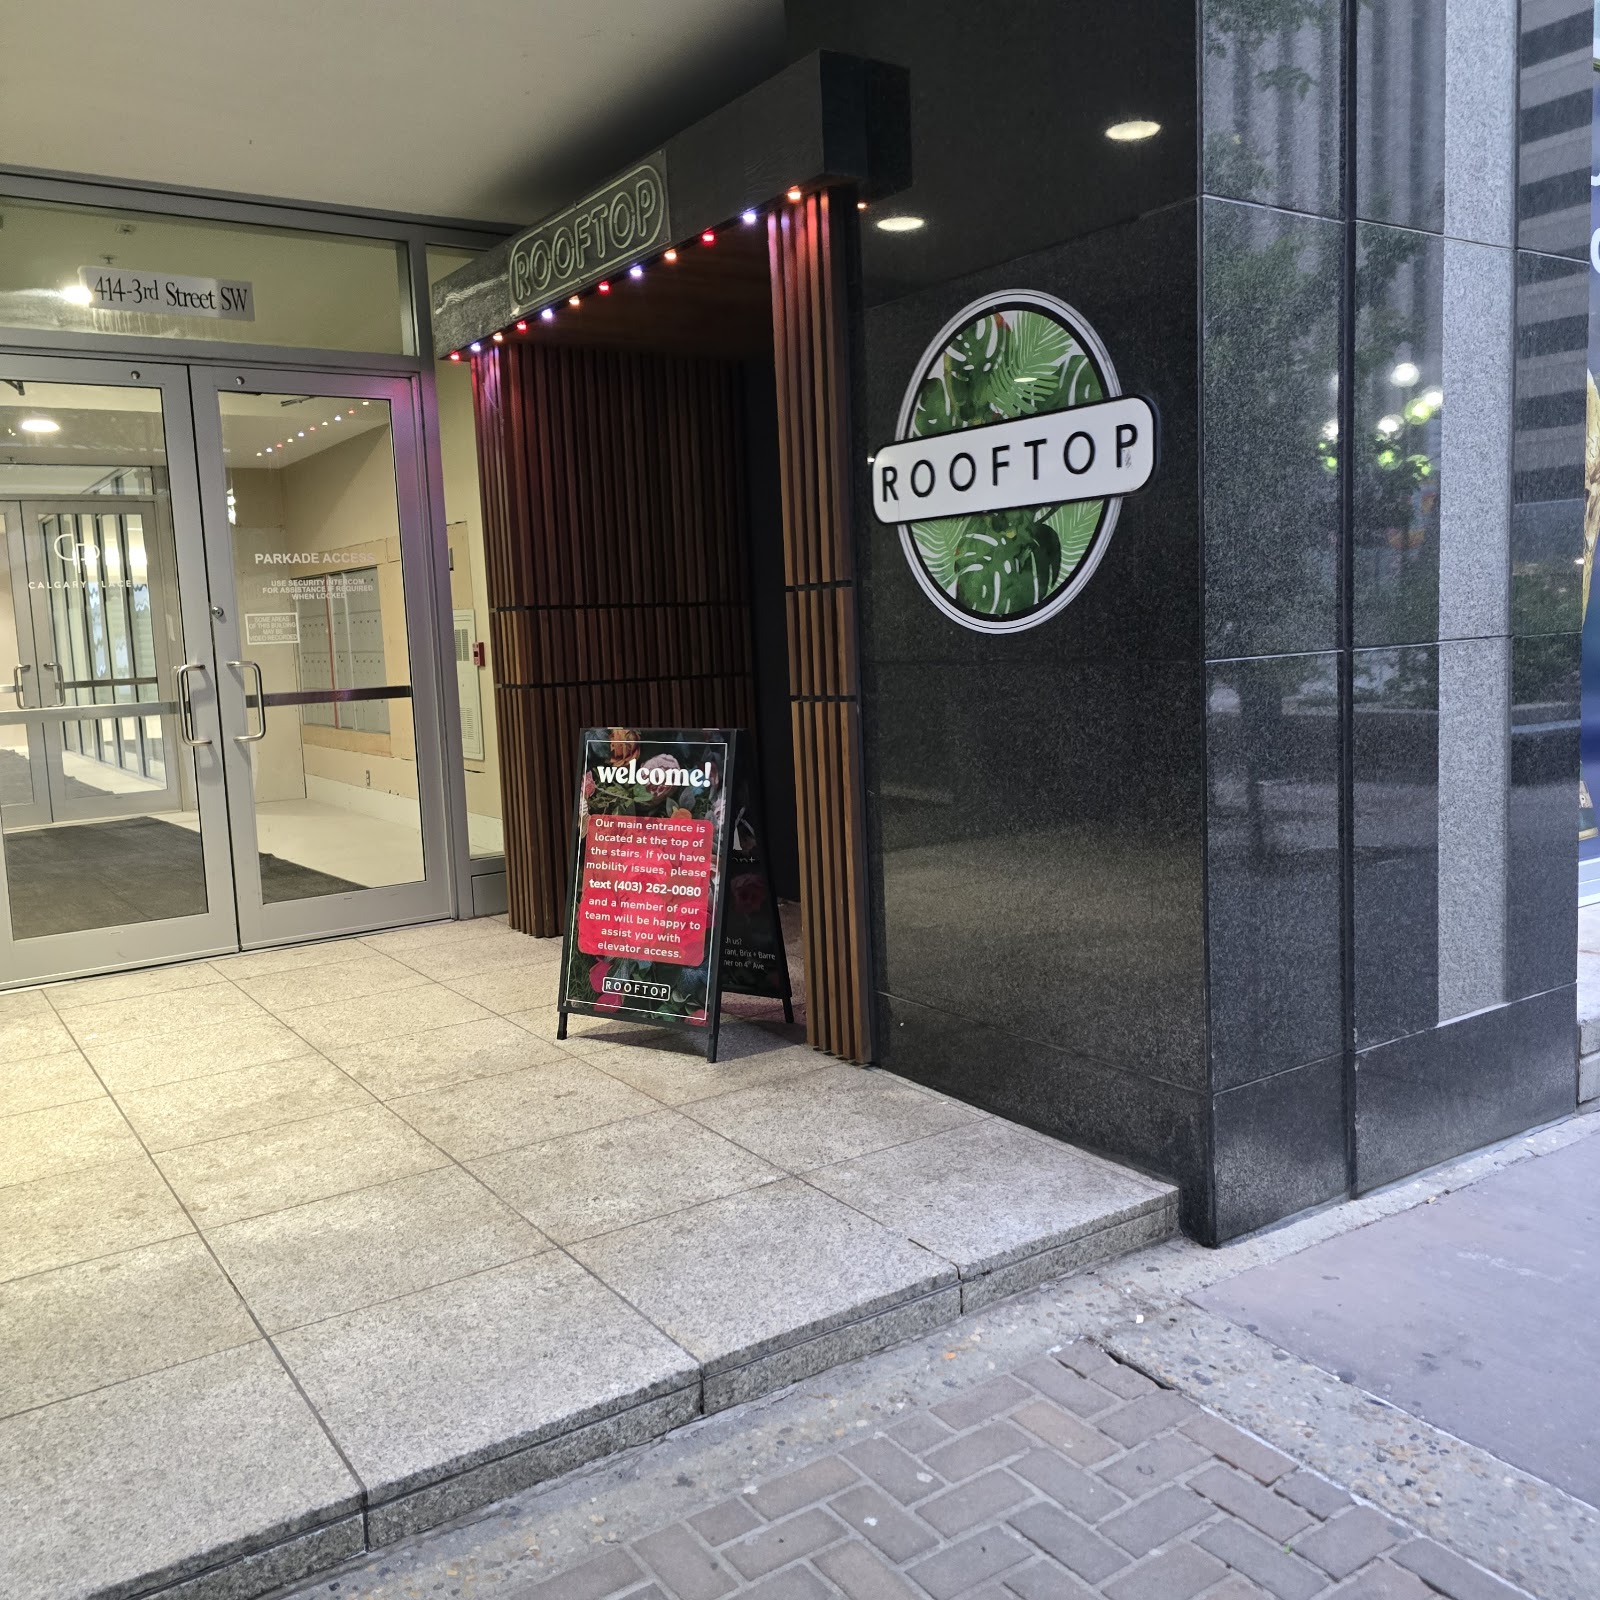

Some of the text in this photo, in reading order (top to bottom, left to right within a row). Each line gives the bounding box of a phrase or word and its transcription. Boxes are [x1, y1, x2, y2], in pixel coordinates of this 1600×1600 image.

[514, 179, 656, 300] ROOFTOP
[95, 276, 247, 311] 414-3rd Street SW
[882, 423, 1138, 502] ROOFTOP
[255, 552, 375, 565] PARKADE ACCESS
[28, 580, 87, 590] CALGARY
[271, 577, 365, 587] USE SECURITY INTERCOM
[280, 586, 327, 594] ASSISTANCE
[336, 584, 374, 592] REQUIRED
[597, 758, 712, 788] welcome!
[595, 818, 706, 833] Our main entrance is
[594, 833, 704, 848] located at the top of
[591, 846, 706, 863] the stairs. If you have
[586, 861, 707, 878] mobility issues, please
[589, 878, 702, 897] text (403) 262-0080
[588, 898, 608, 906] and
[620, 900, 664, 912] member
[666, 904, 679, 913] of
[681, 906, 699, 915] our
[585, 911, 701, 931] team will be happy to
[601, 928, 681, 944] assist you with
[732, 937, 743, 945] us?
[597, 941, 682, 959] elevator access.
[739, 949, 752, 958] Brix
[757, 951, 776, 961] Barre
[752, 962, 765, 971] Ave
[605, 980, 668, 998] ROOFTOP
